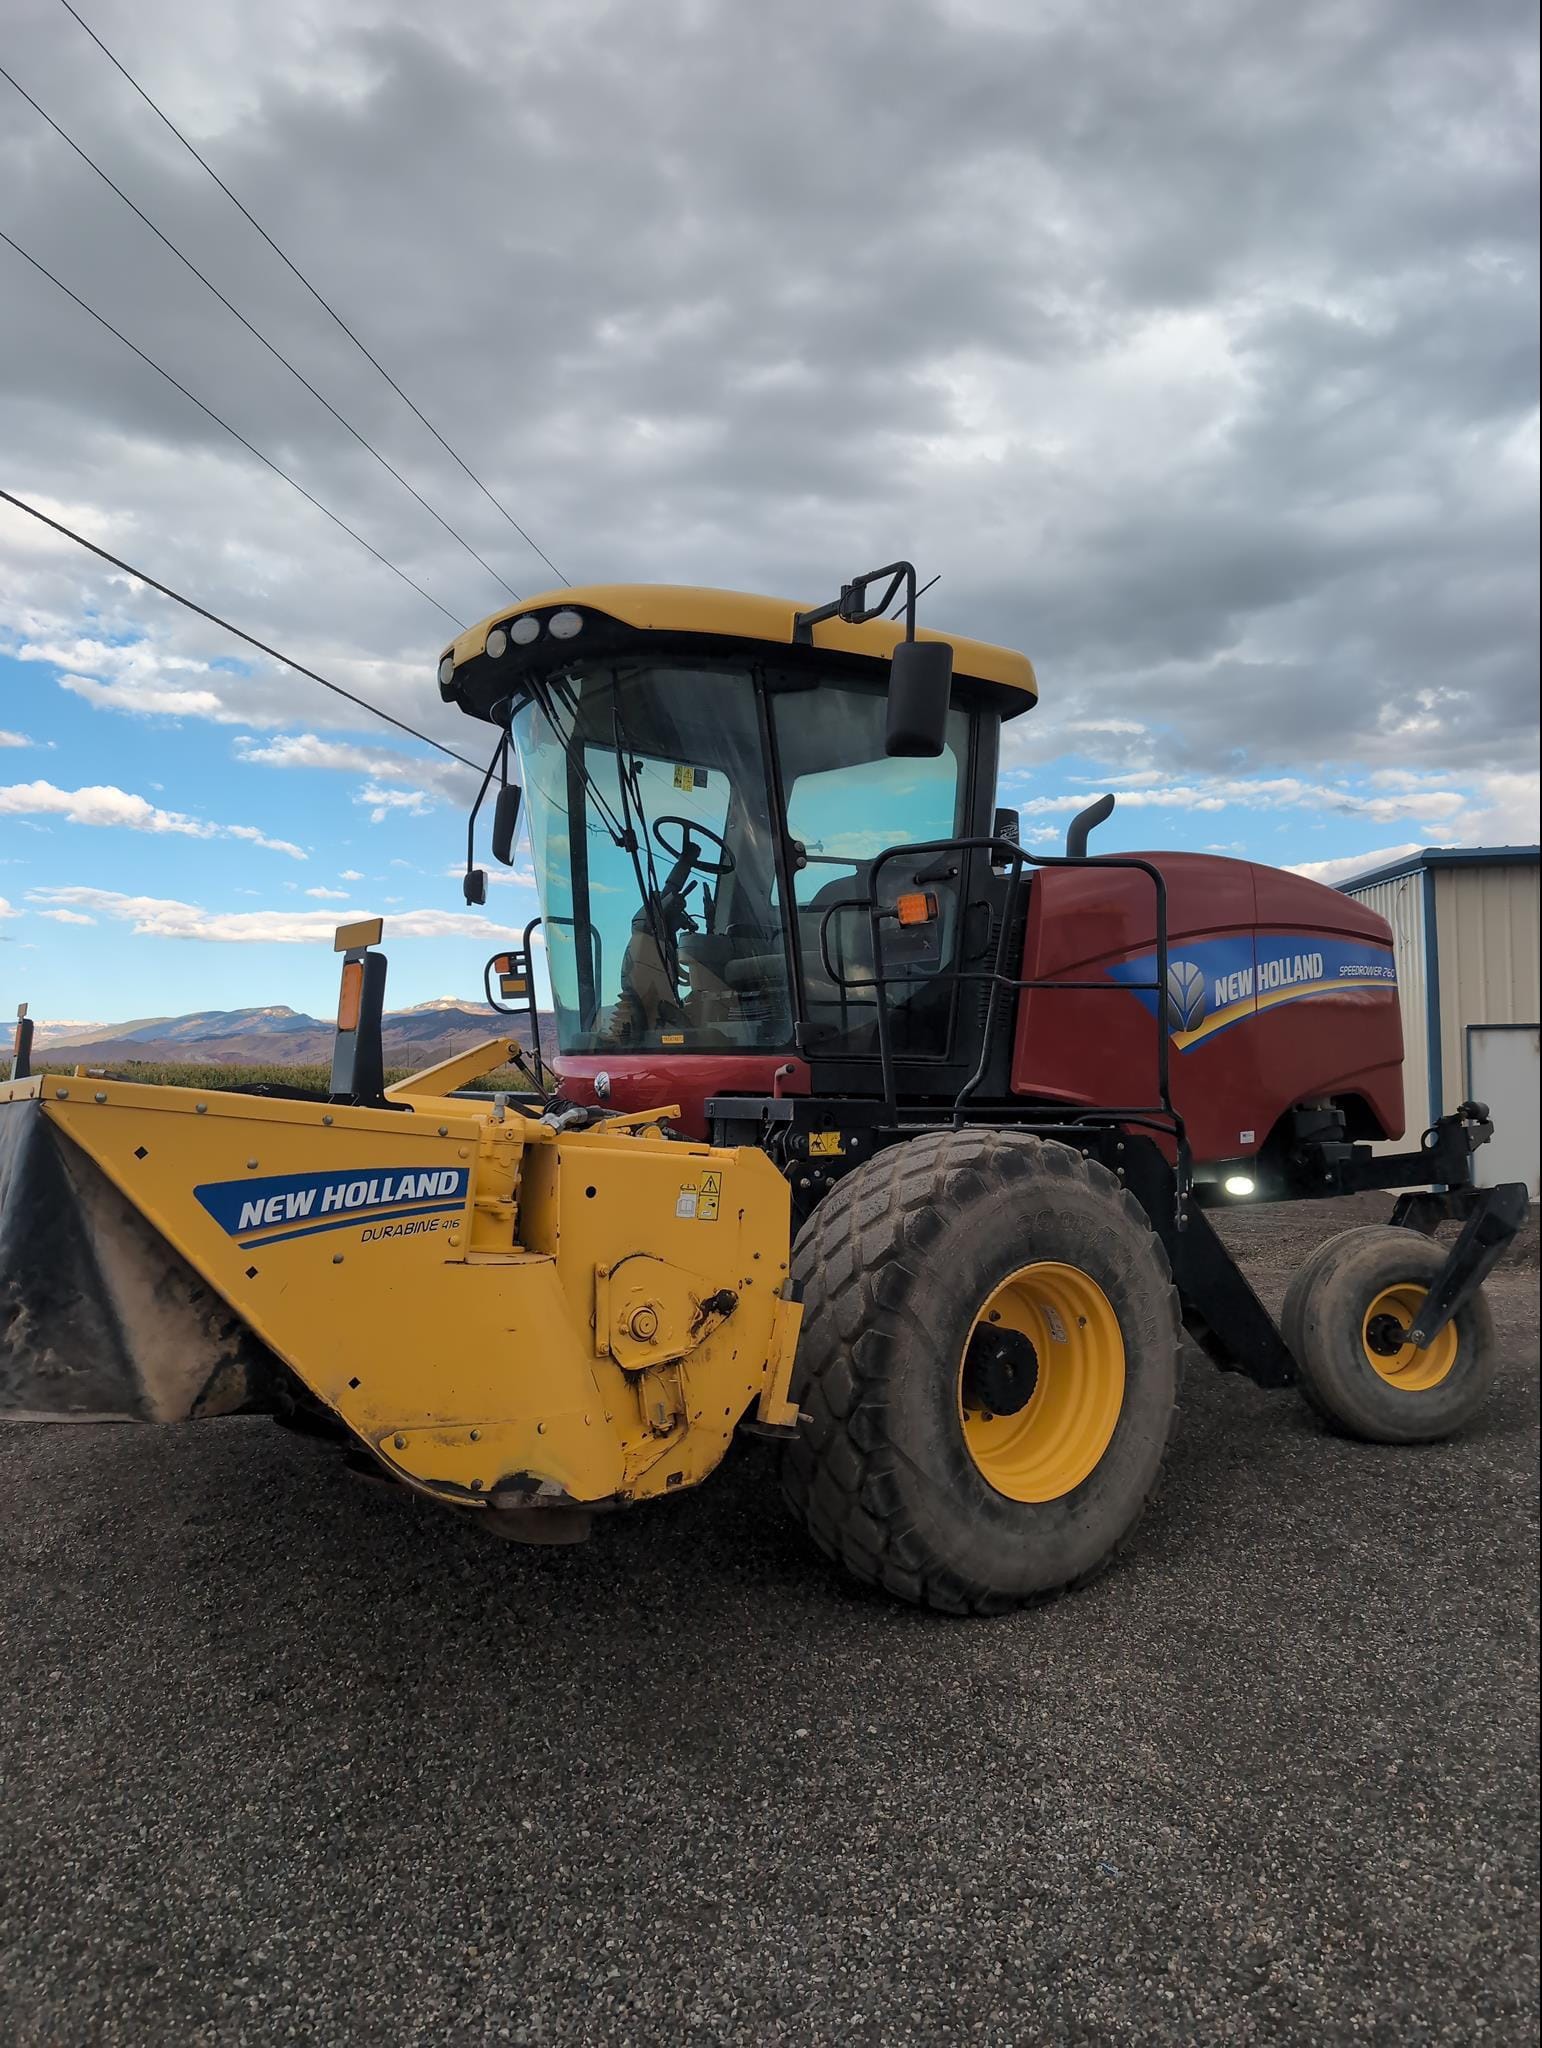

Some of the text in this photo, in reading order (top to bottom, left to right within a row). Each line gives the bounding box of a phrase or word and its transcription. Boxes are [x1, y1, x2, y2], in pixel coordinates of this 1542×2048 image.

[1215, 952, 1324, 1007] NEW HOLLAND
[1339, 965, 1382, 977] SPEEDROWER
[237, 1170, 460, 1230] NEW HOLLAND
[361, 1218, 461, 1243] DURABINE 416
